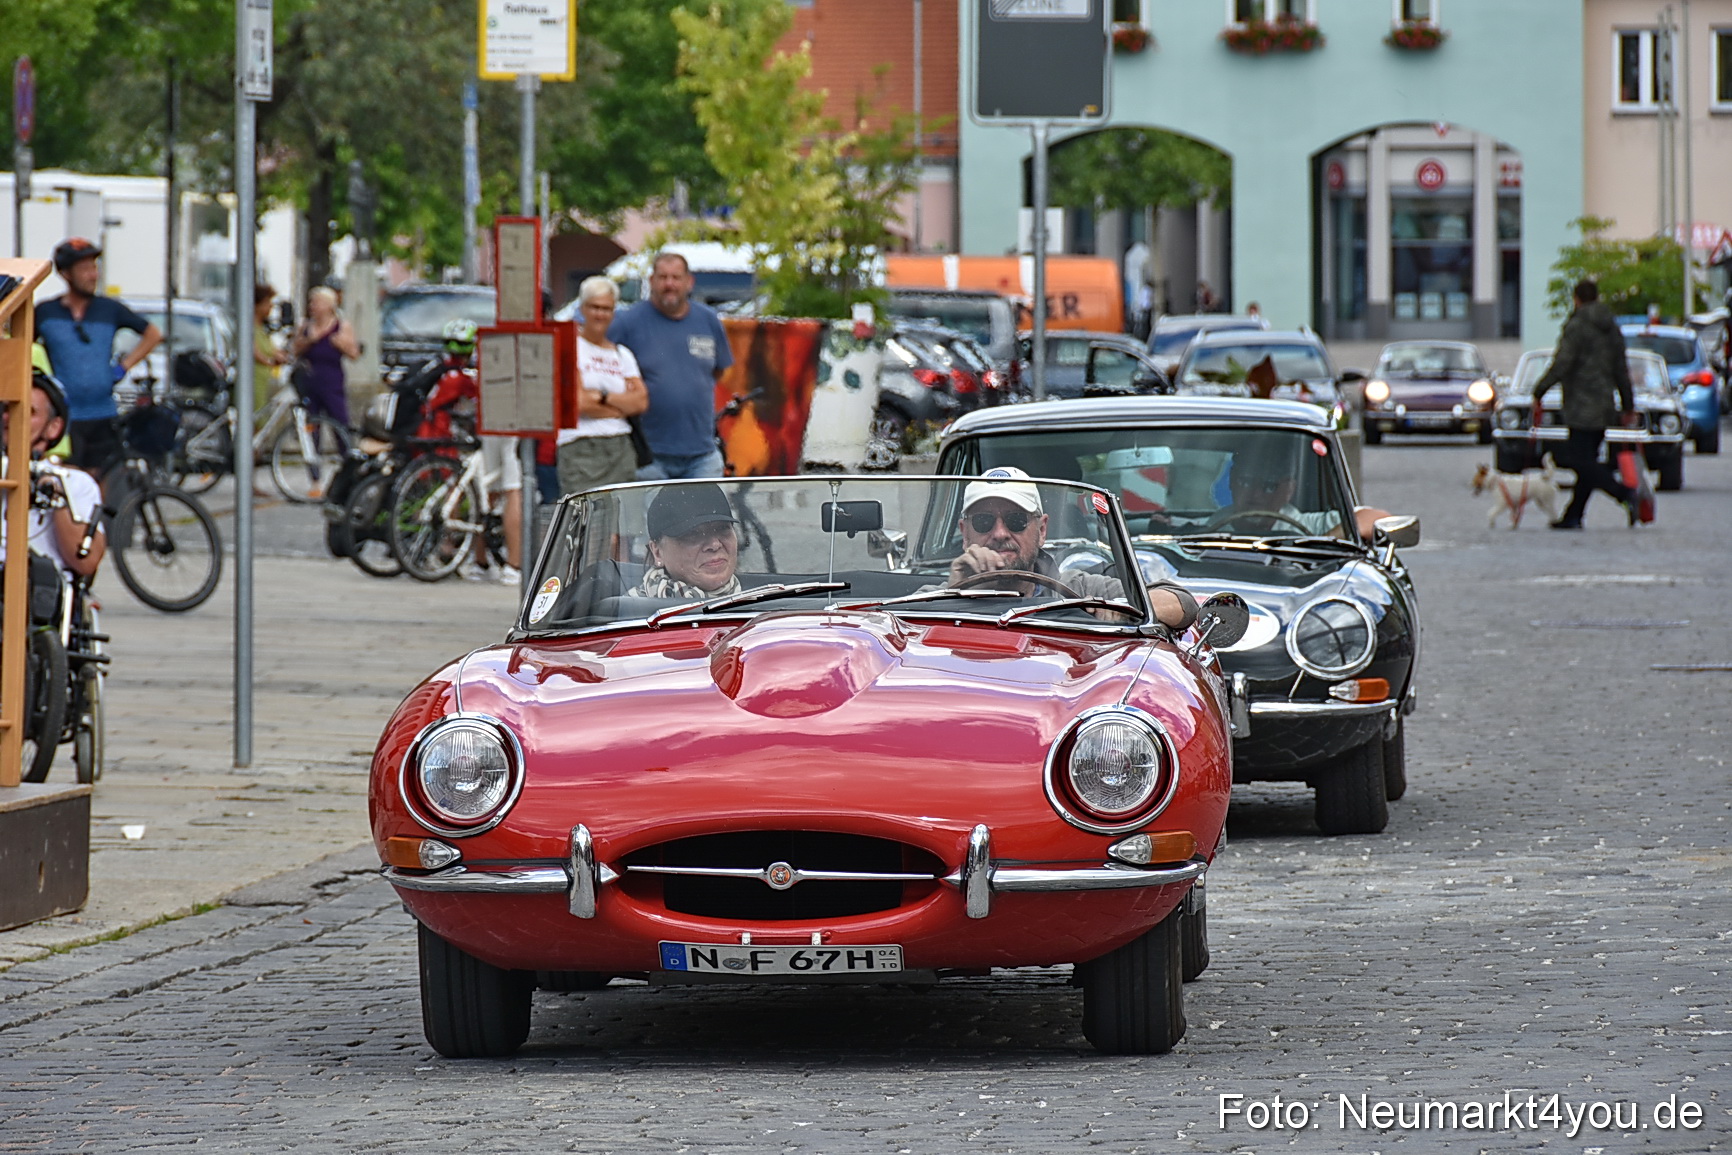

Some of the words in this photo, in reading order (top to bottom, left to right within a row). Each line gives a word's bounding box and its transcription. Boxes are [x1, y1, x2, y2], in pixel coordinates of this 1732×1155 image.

[503, 2, 549, 15] Rathaus
[691, 948, 719, 969] N
[750, 951, 776, 971] F
[789, 950, 874, 970] 67H
[878, 949, 897, 957] 04
